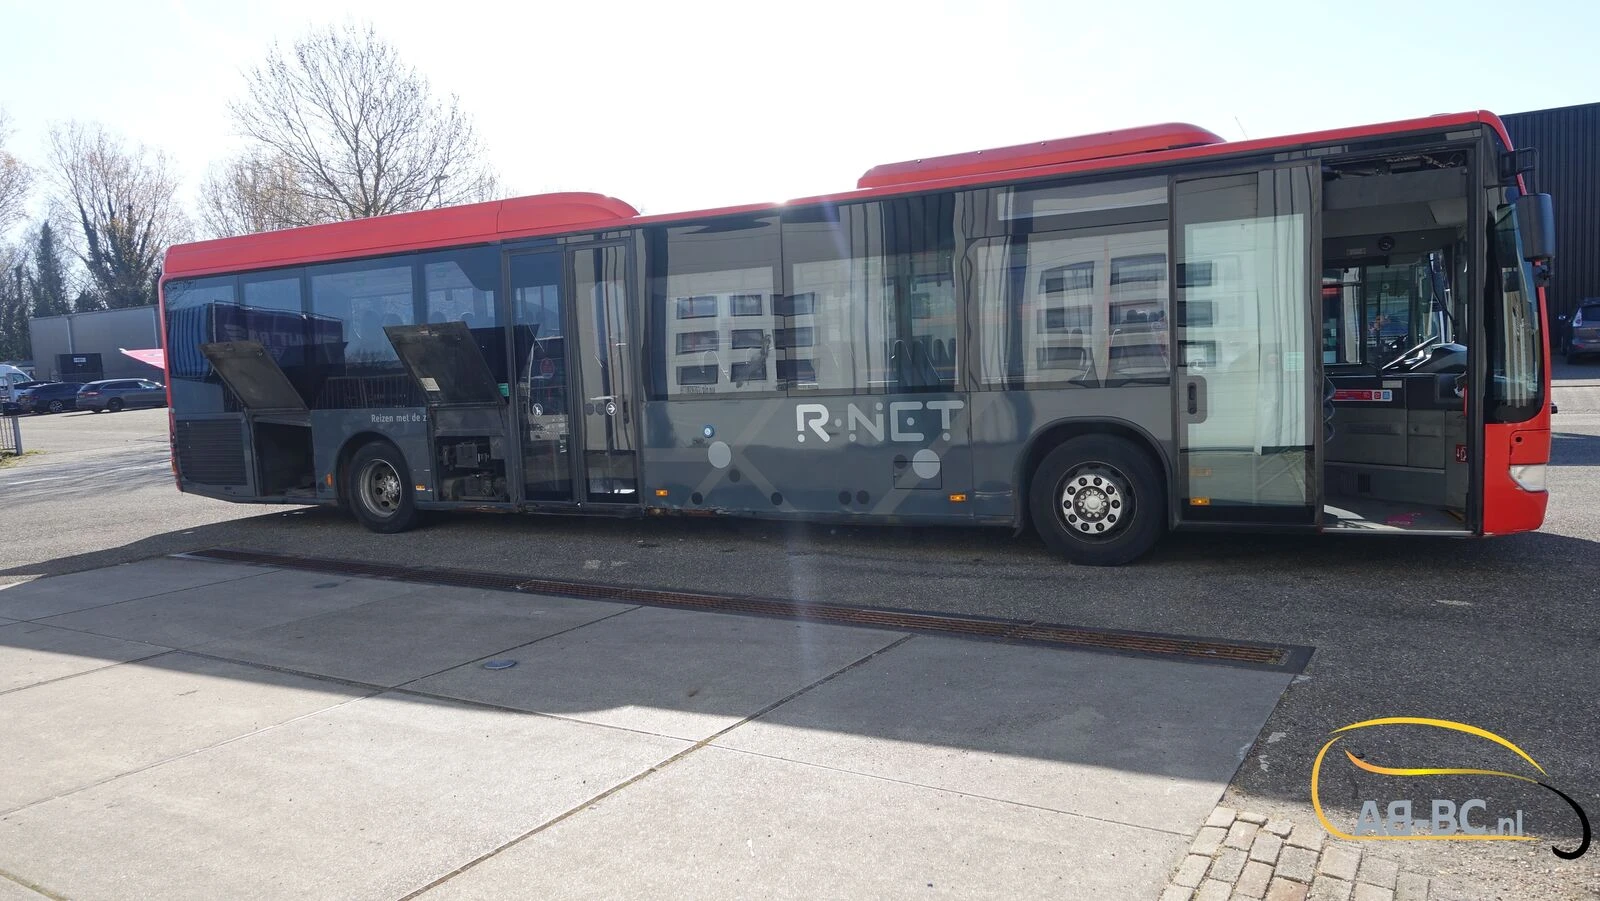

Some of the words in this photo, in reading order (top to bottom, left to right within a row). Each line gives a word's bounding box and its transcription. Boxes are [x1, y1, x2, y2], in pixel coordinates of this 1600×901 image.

[371, 414, 394, 422] Reizen
[396, 413, 410, 422] met
[411, 412, 421, 422] de
